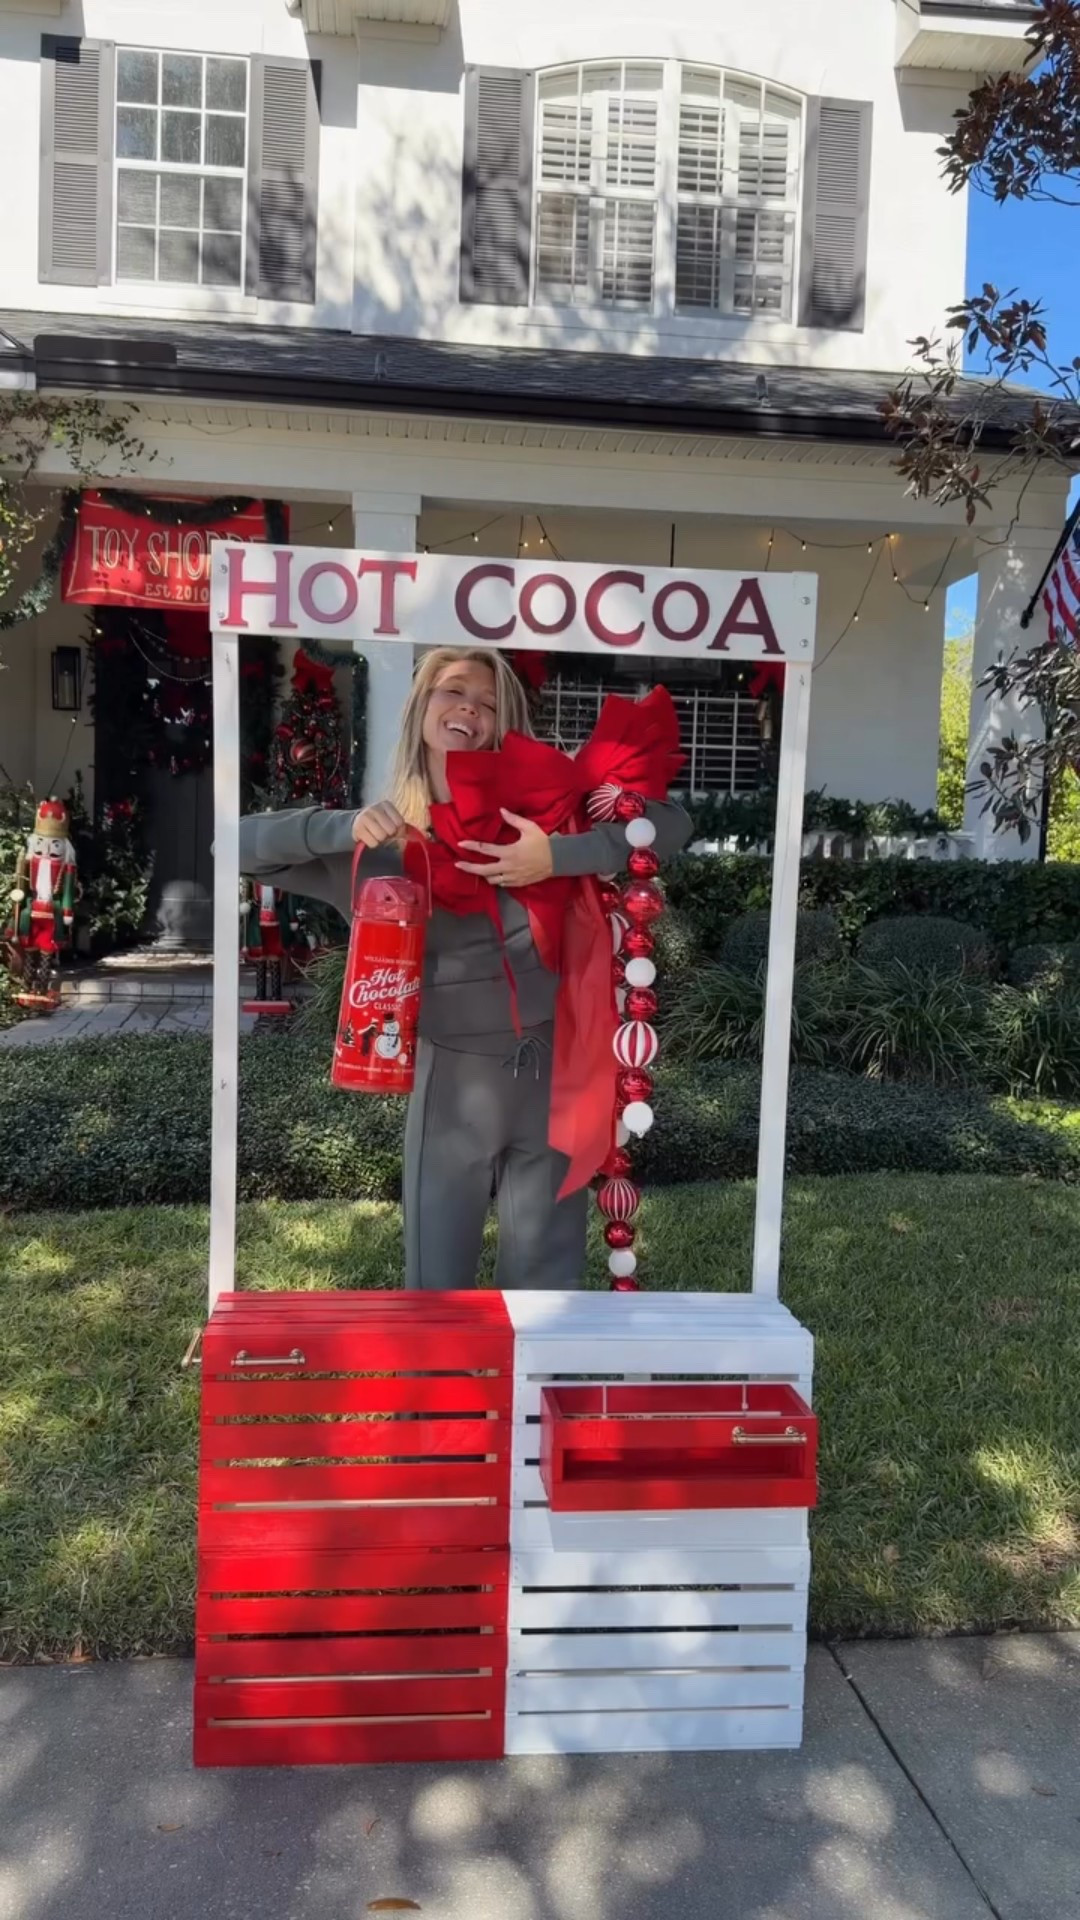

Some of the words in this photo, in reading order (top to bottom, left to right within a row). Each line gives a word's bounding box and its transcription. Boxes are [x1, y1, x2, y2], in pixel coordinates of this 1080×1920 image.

[84, 525, 140, 572] TOY
[147, 530, 267, 581] SHO
[220, 547, 418, 635] HOT
[454, 563, 785, 655] COCOA
[370, 967, 406, 987] Hot
